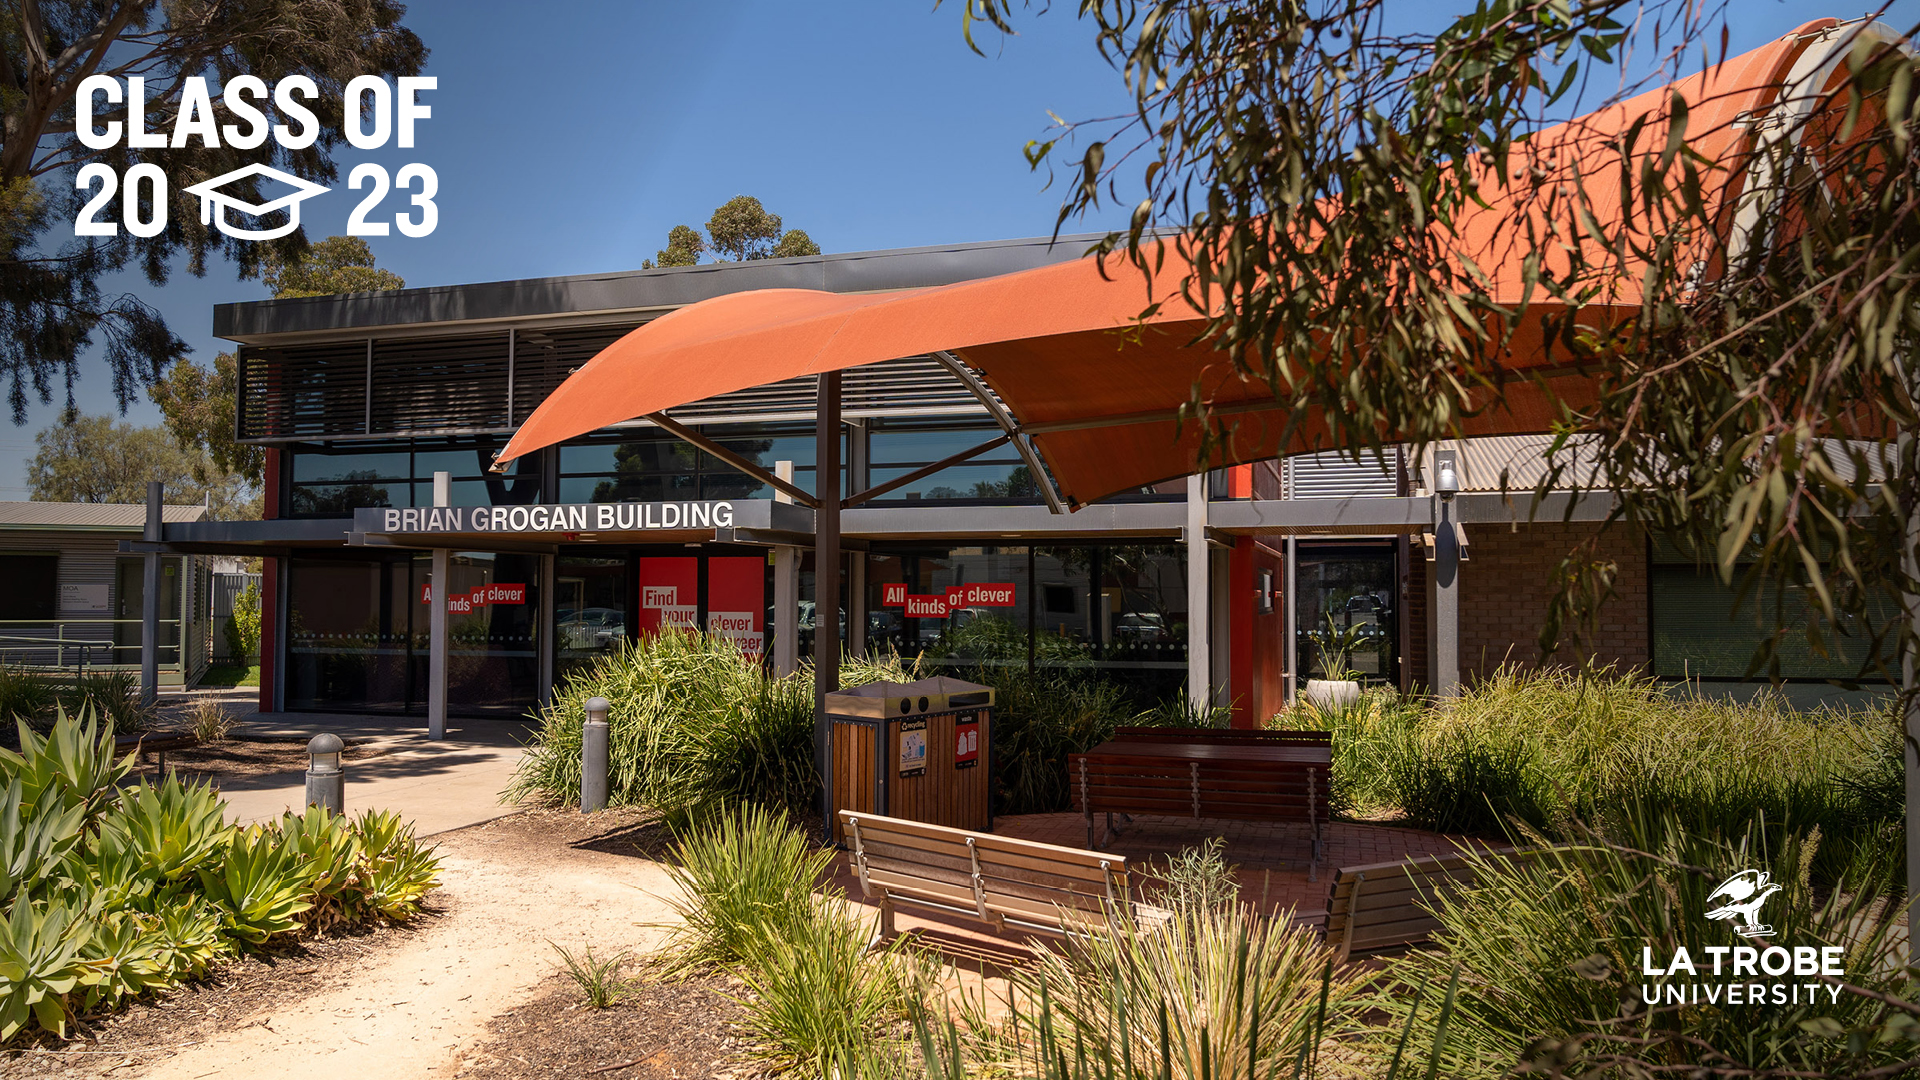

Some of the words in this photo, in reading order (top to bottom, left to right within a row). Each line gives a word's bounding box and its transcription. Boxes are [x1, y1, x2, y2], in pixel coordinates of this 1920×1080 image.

[384, 507, 463, 532] BRIAN
[470, 505, 588, 532] GROGAN
[597, 502, 734, 529] BUILDING
[448, 598, 470, 611] inds
[472, 590, 485, 604] of
[488, 586, 523, 601] clever
[645, 590, 674, 606] Find
[886, 587, 905, 603] All
[908, 599, 946, 614] kinds
[949, 590, 963, 606] of
[967, 587, 1012, 603] clever
[664, 610, 695, 625] your
[711, 614, 751, 631] clever
[719, 637, 762, 650] reer
[907, 721, 925, 729] recycling
